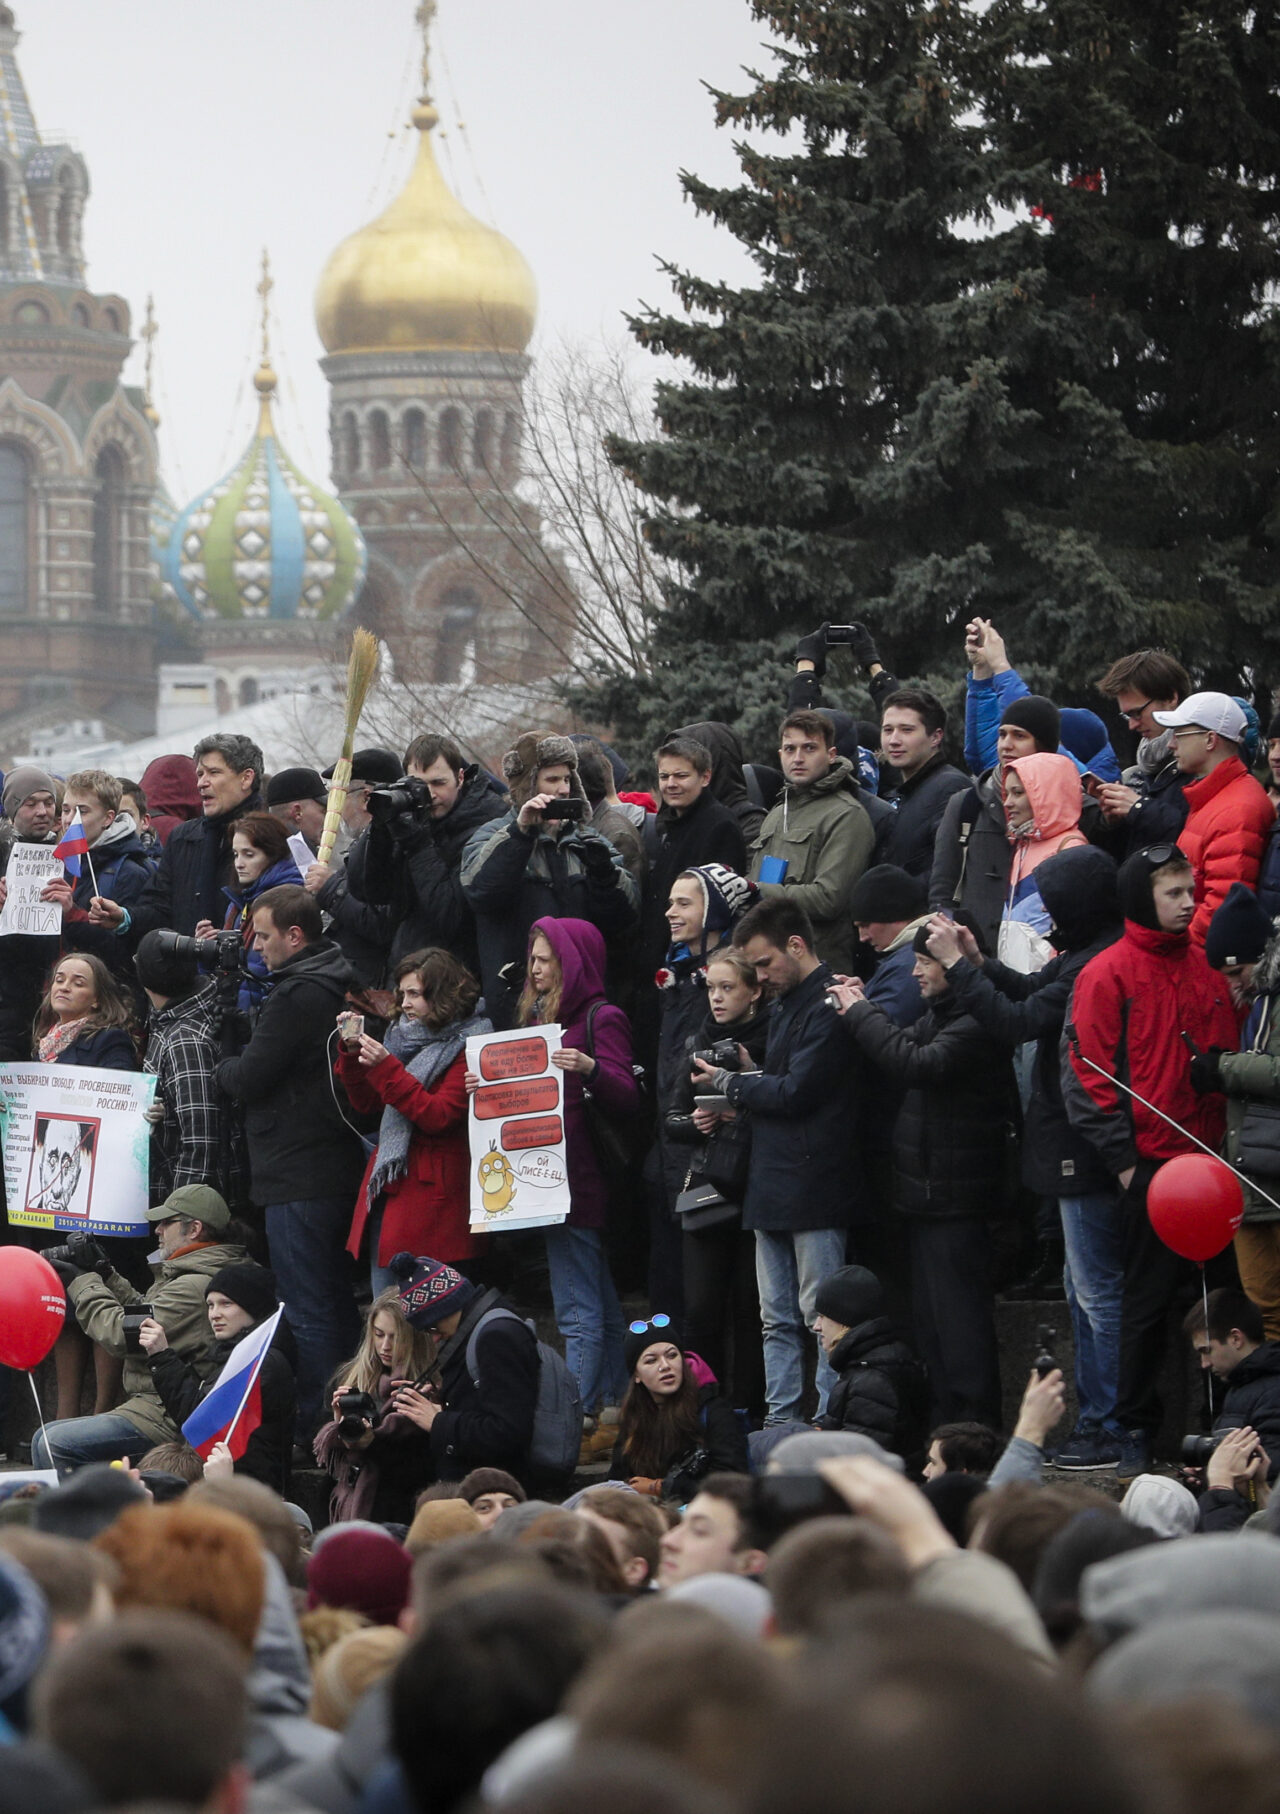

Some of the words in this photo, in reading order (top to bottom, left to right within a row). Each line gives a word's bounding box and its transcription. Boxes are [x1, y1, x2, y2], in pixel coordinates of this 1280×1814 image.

[0, 1075, 14, 1085] МЫ
[17, 1074, 49, 1086] ВЫБИРАЕМ
[536, 1155, 550, 1167] ОЙ
